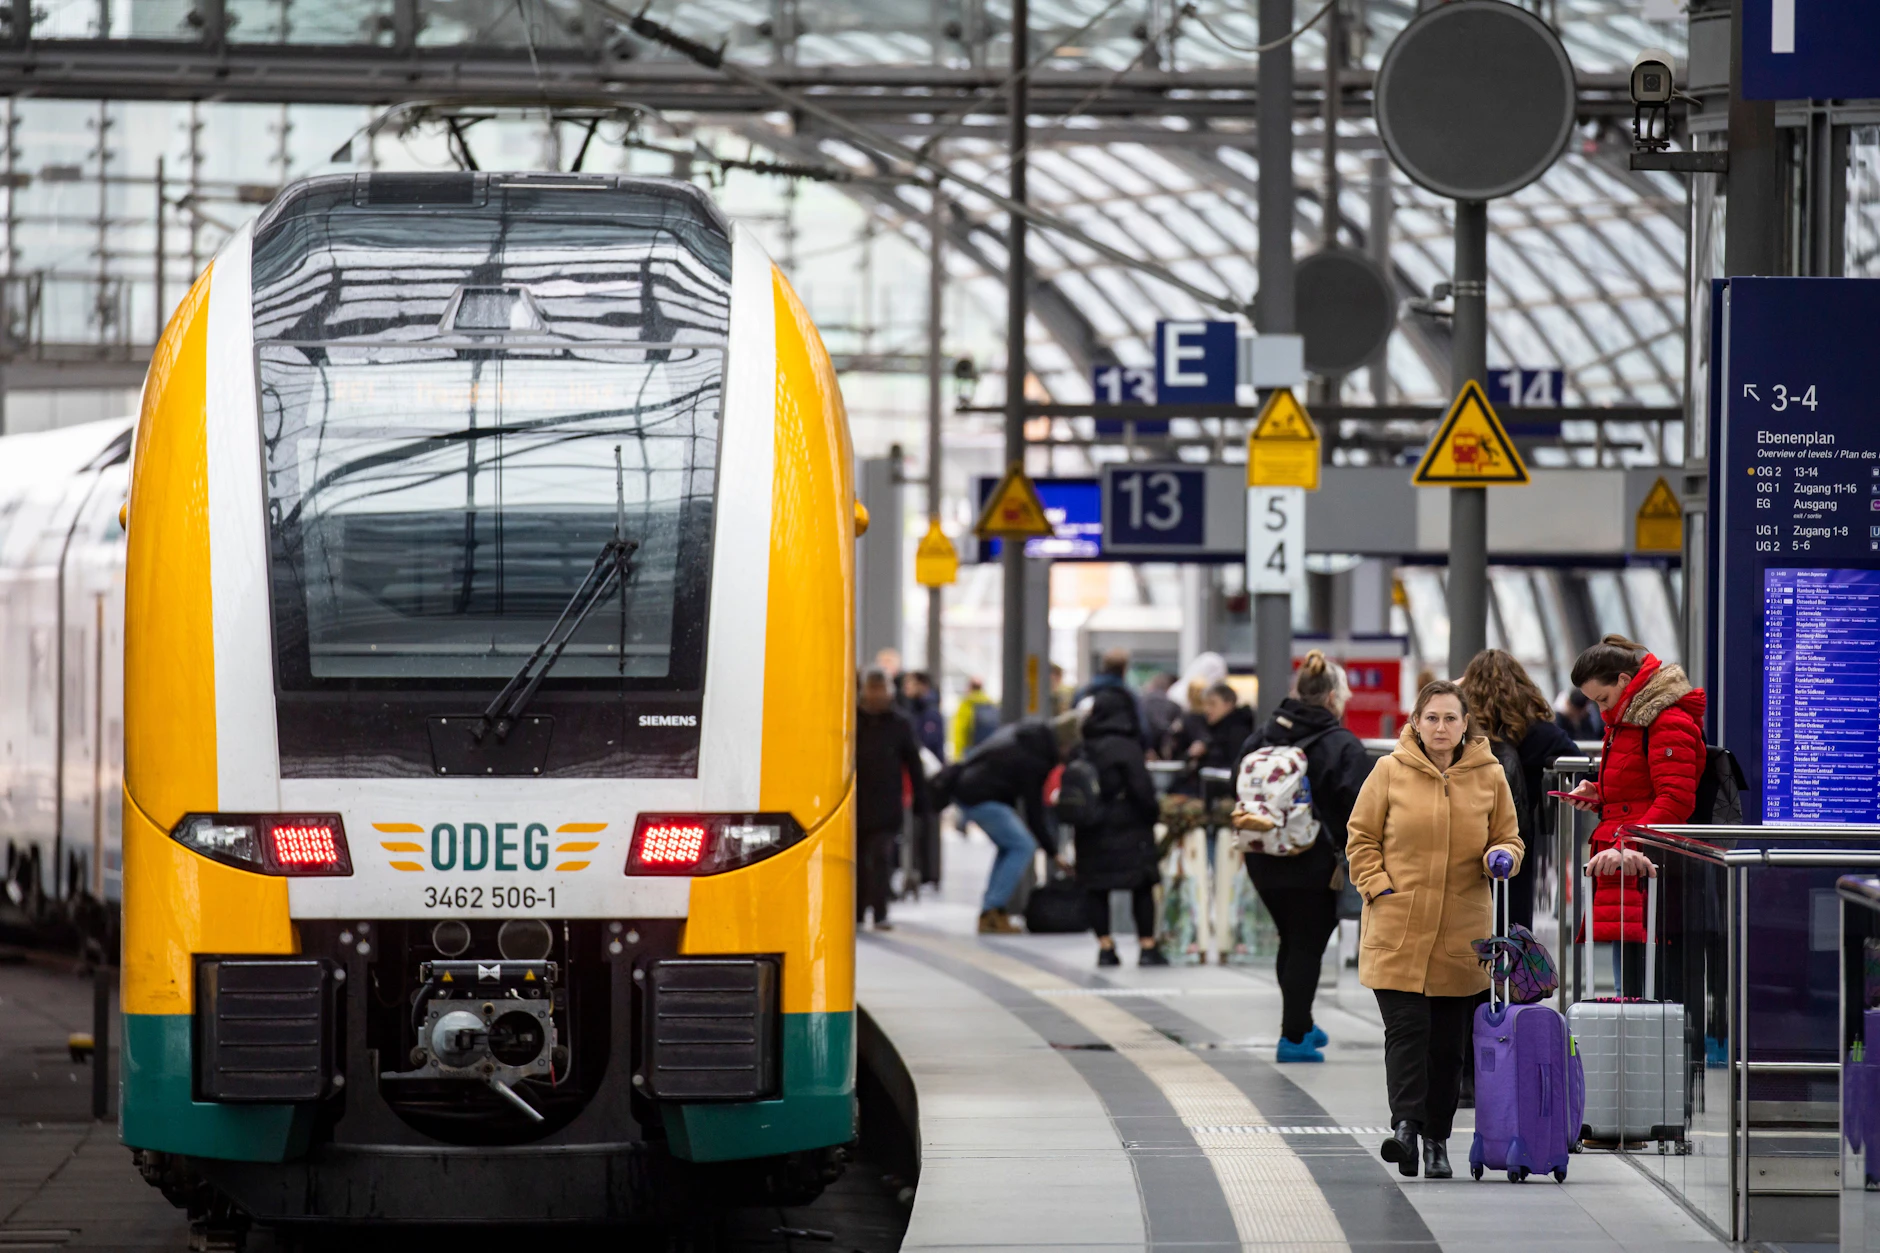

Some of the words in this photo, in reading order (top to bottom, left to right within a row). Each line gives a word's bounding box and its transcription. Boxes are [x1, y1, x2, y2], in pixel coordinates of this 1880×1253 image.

[1164, 322, 1207, 387] E
[1499, 370, 1556, 408] 14
[1771, 384, 1818, 411] 3-4
[1758, 431, 1835, 446] Ebenenplan
[1758, 449, 1796, 458] Overview
[1798, 449, 1806, 458] of
[1808, 450, 1832, 458] levels
[1840, 450, 1859, 458] Plan
[1862, 450, 1876, 458] des
[1757, 466, 1772, 476] OG
[1775, 467, 1781, 476] 2
[1794, 467, 1818, 477] 13-14
[1757, 482, 1772, 492] OG
[1775, 484, 1779, 492] 1
[1794, 483, 1831, 495] Zugang
[1834, 484, 1857, 493] 11-16
[1118, 473, 1183, 530] 13
[1756, 498, 1770, 508] EG
[1794, 499, 1837, 511] Ausgang
[1265, 496, 1287, 532] 5
[1756, 525, 1771, 535] UG
[1774, 526, 1778, 535] 1
[1793, 526, 1830, 538] Zugang
[1833, 526, 1848, 536] 1-8
[1756, 542, 1771, 551] UG
[1774, 542, 1780, 551] 2
[1266, 541, 1286, 574] 4
[639, 715, 697, 726] SIEMENS
[431, 822, 549, 871] ODEG
[424, 886, 483, 909] 3462
[492, 886, 555, 909] 506-1
